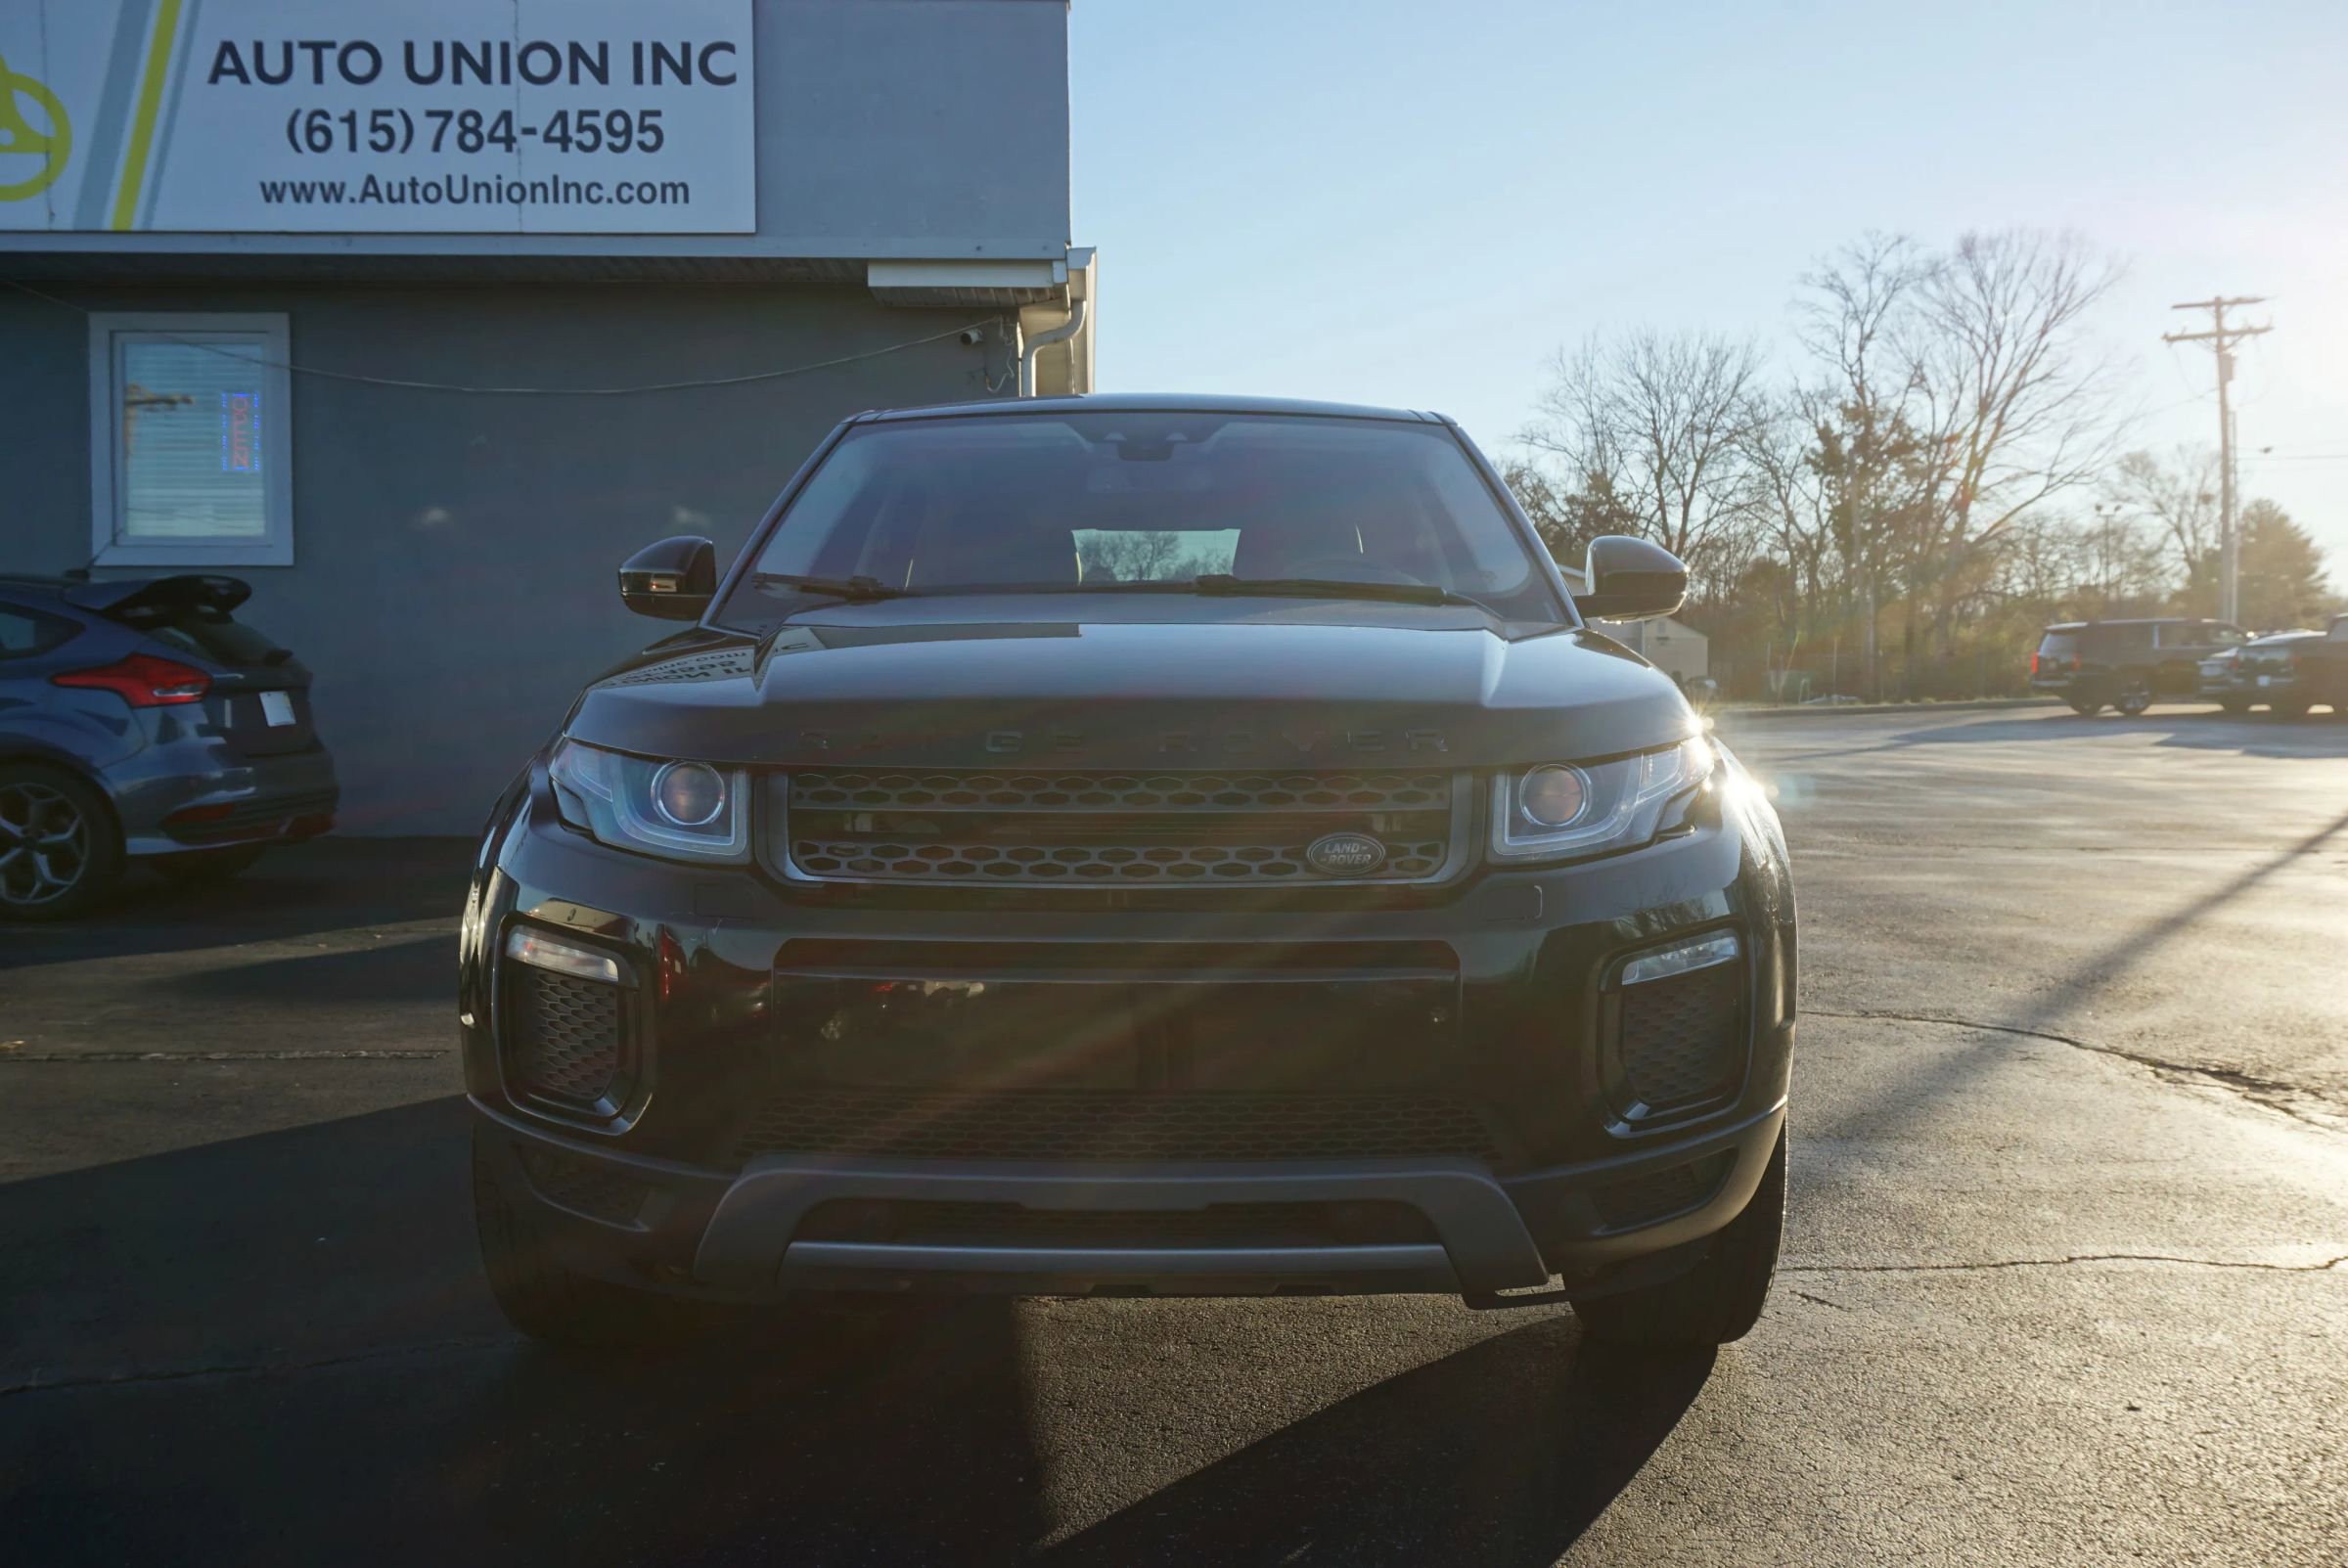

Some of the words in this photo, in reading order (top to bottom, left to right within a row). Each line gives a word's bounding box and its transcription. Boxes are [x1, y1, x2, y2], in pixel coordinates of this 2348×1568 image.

[206, 39, 384, 86] AUTO
[403, 40, 610, 86] UNION
[631, 40, 739, 86] INC
[259, 173, 691, 206] www.AutoUnionInc.com
[797, 729, 1089, 753] RGE
